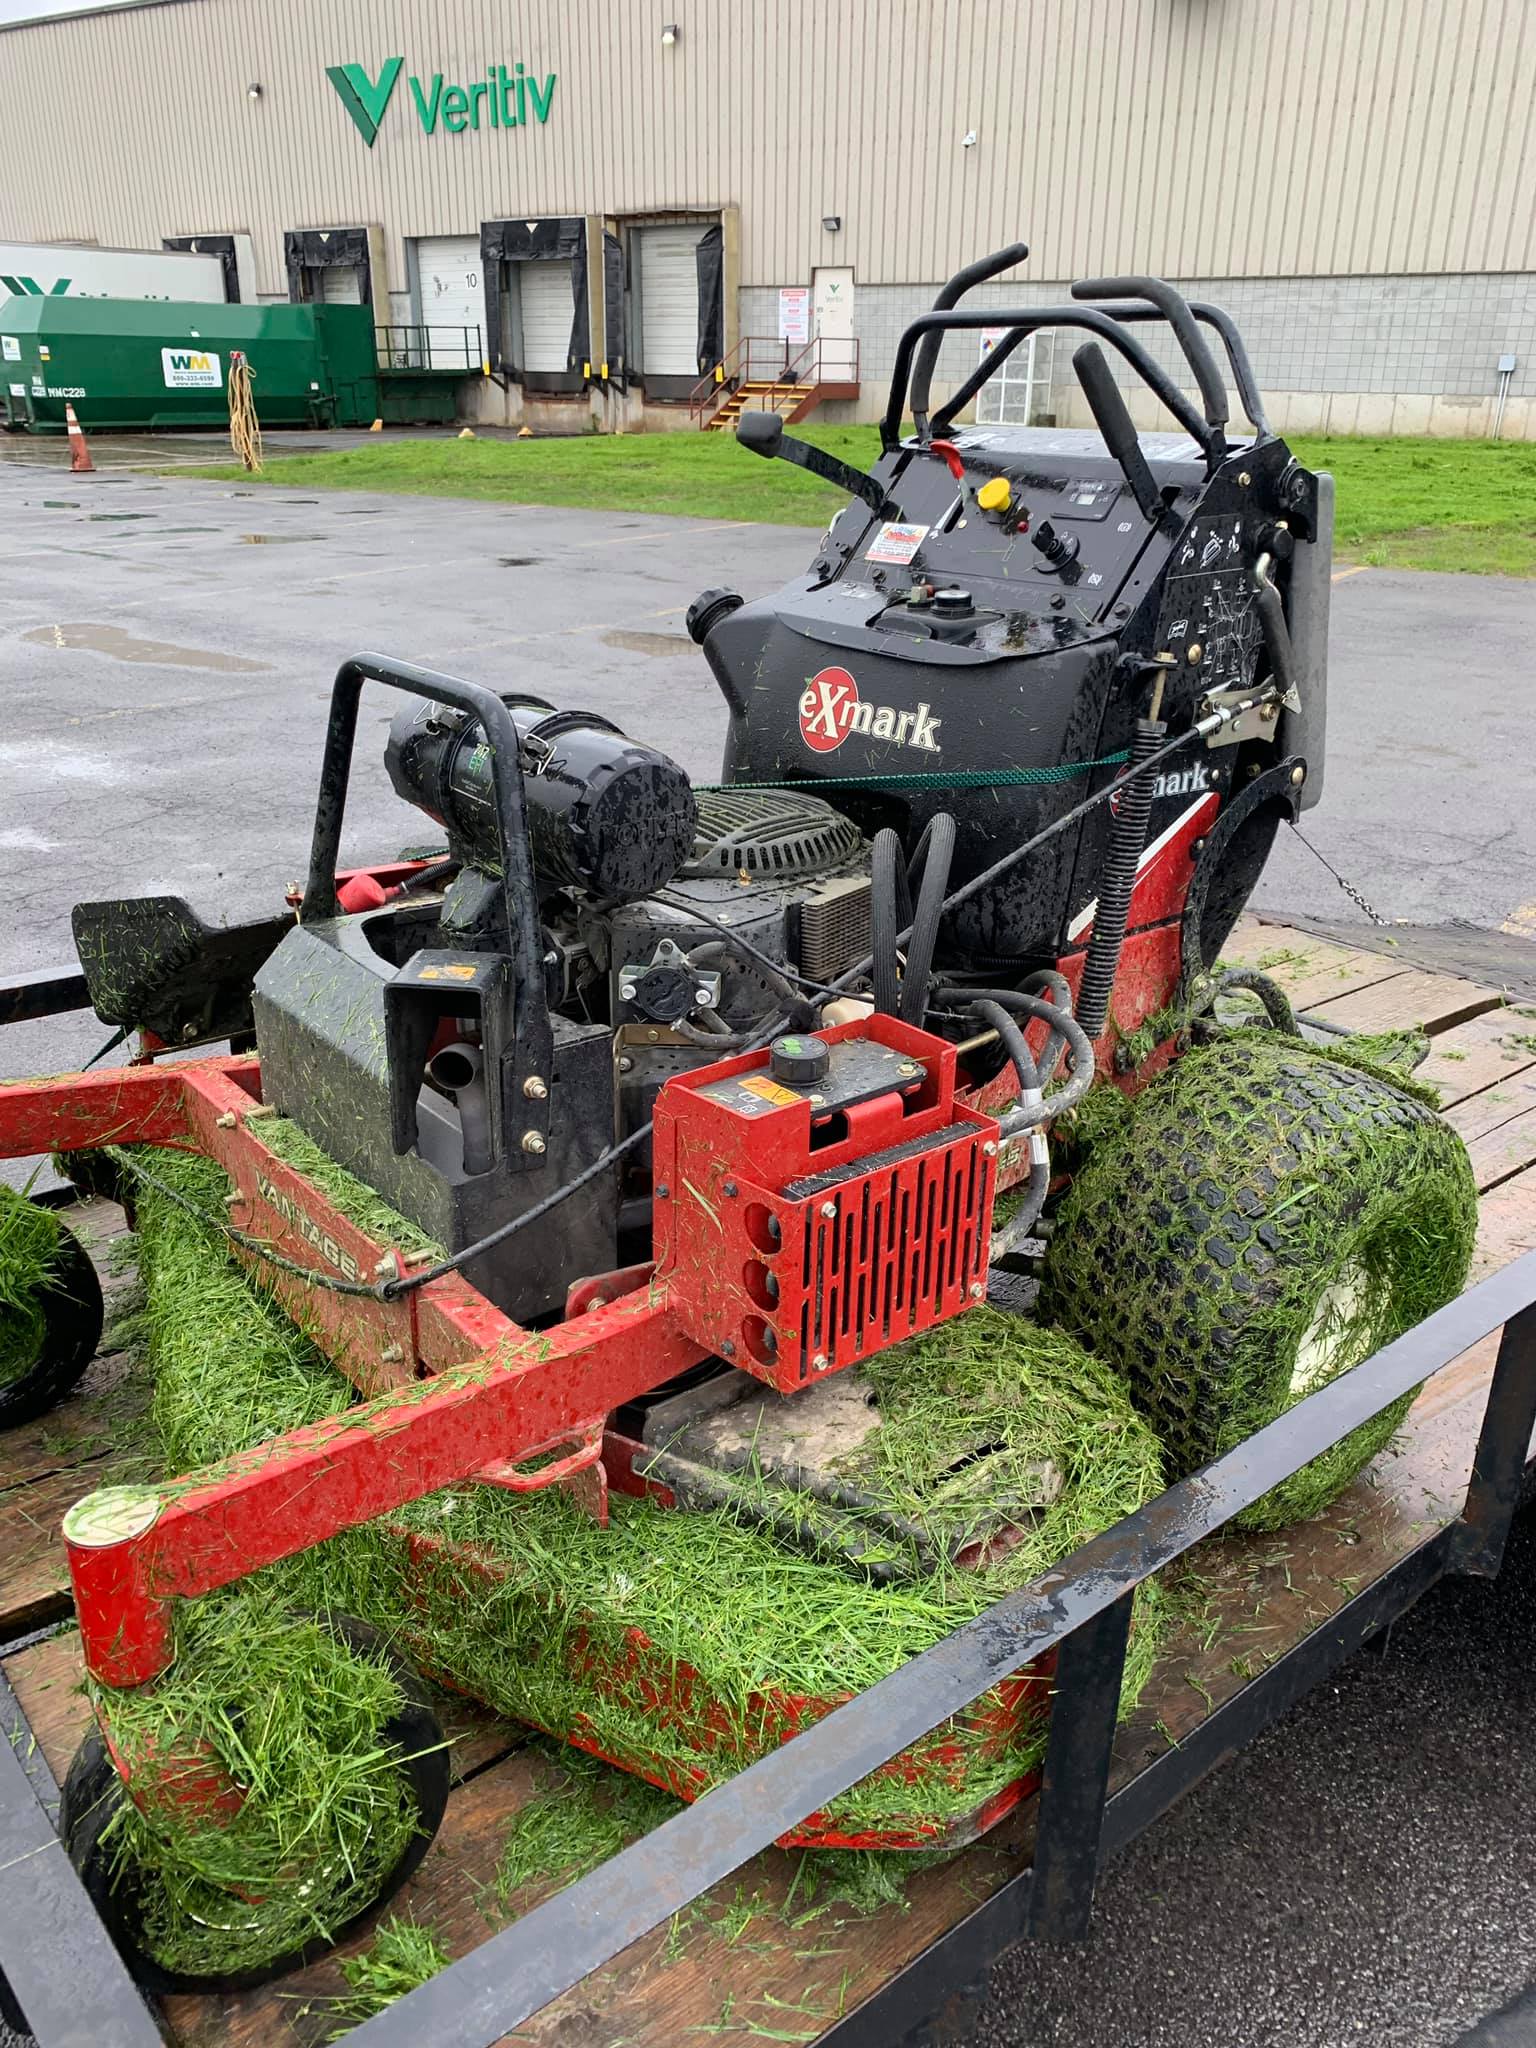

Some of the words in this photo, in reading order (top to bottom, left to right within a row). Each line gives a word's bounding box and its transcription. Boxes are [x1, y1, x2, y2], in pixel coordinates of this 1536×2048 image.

[408, 62, 557, 135] Veritiv
[465, 273, 477, 288] 10
[170, 355, 212, 370] WM
[255, 1169, 358, 1282] VANTAGE
